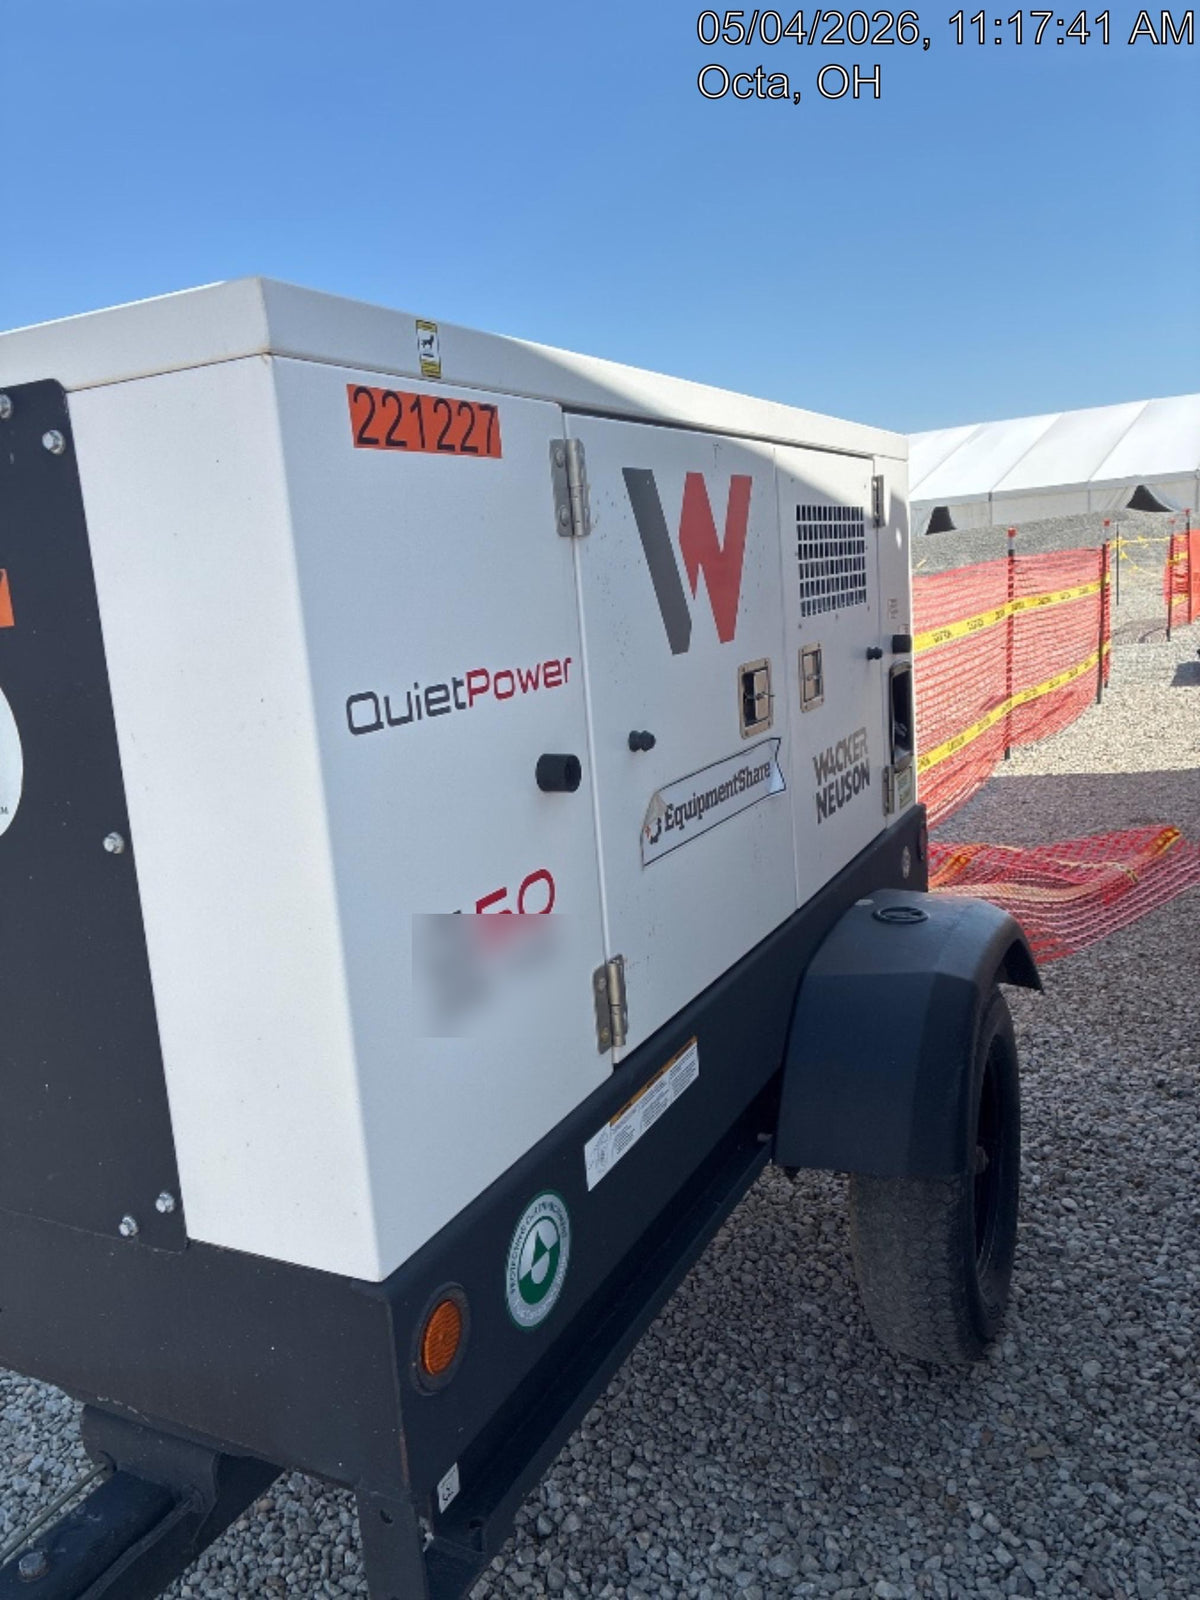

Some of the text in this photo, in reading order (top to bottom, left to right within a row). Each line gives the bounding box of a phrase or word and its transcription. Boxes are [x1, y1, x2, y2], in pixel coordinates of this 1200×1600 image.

[352, 385, 497, 454] 221227
[345, 657, 572, 736] QuietPower
[812, 726, 869, 787] WACKER
[664, 761, 771, 831] EquipmentShare
[815, 758, 871, 825] NEUSON
